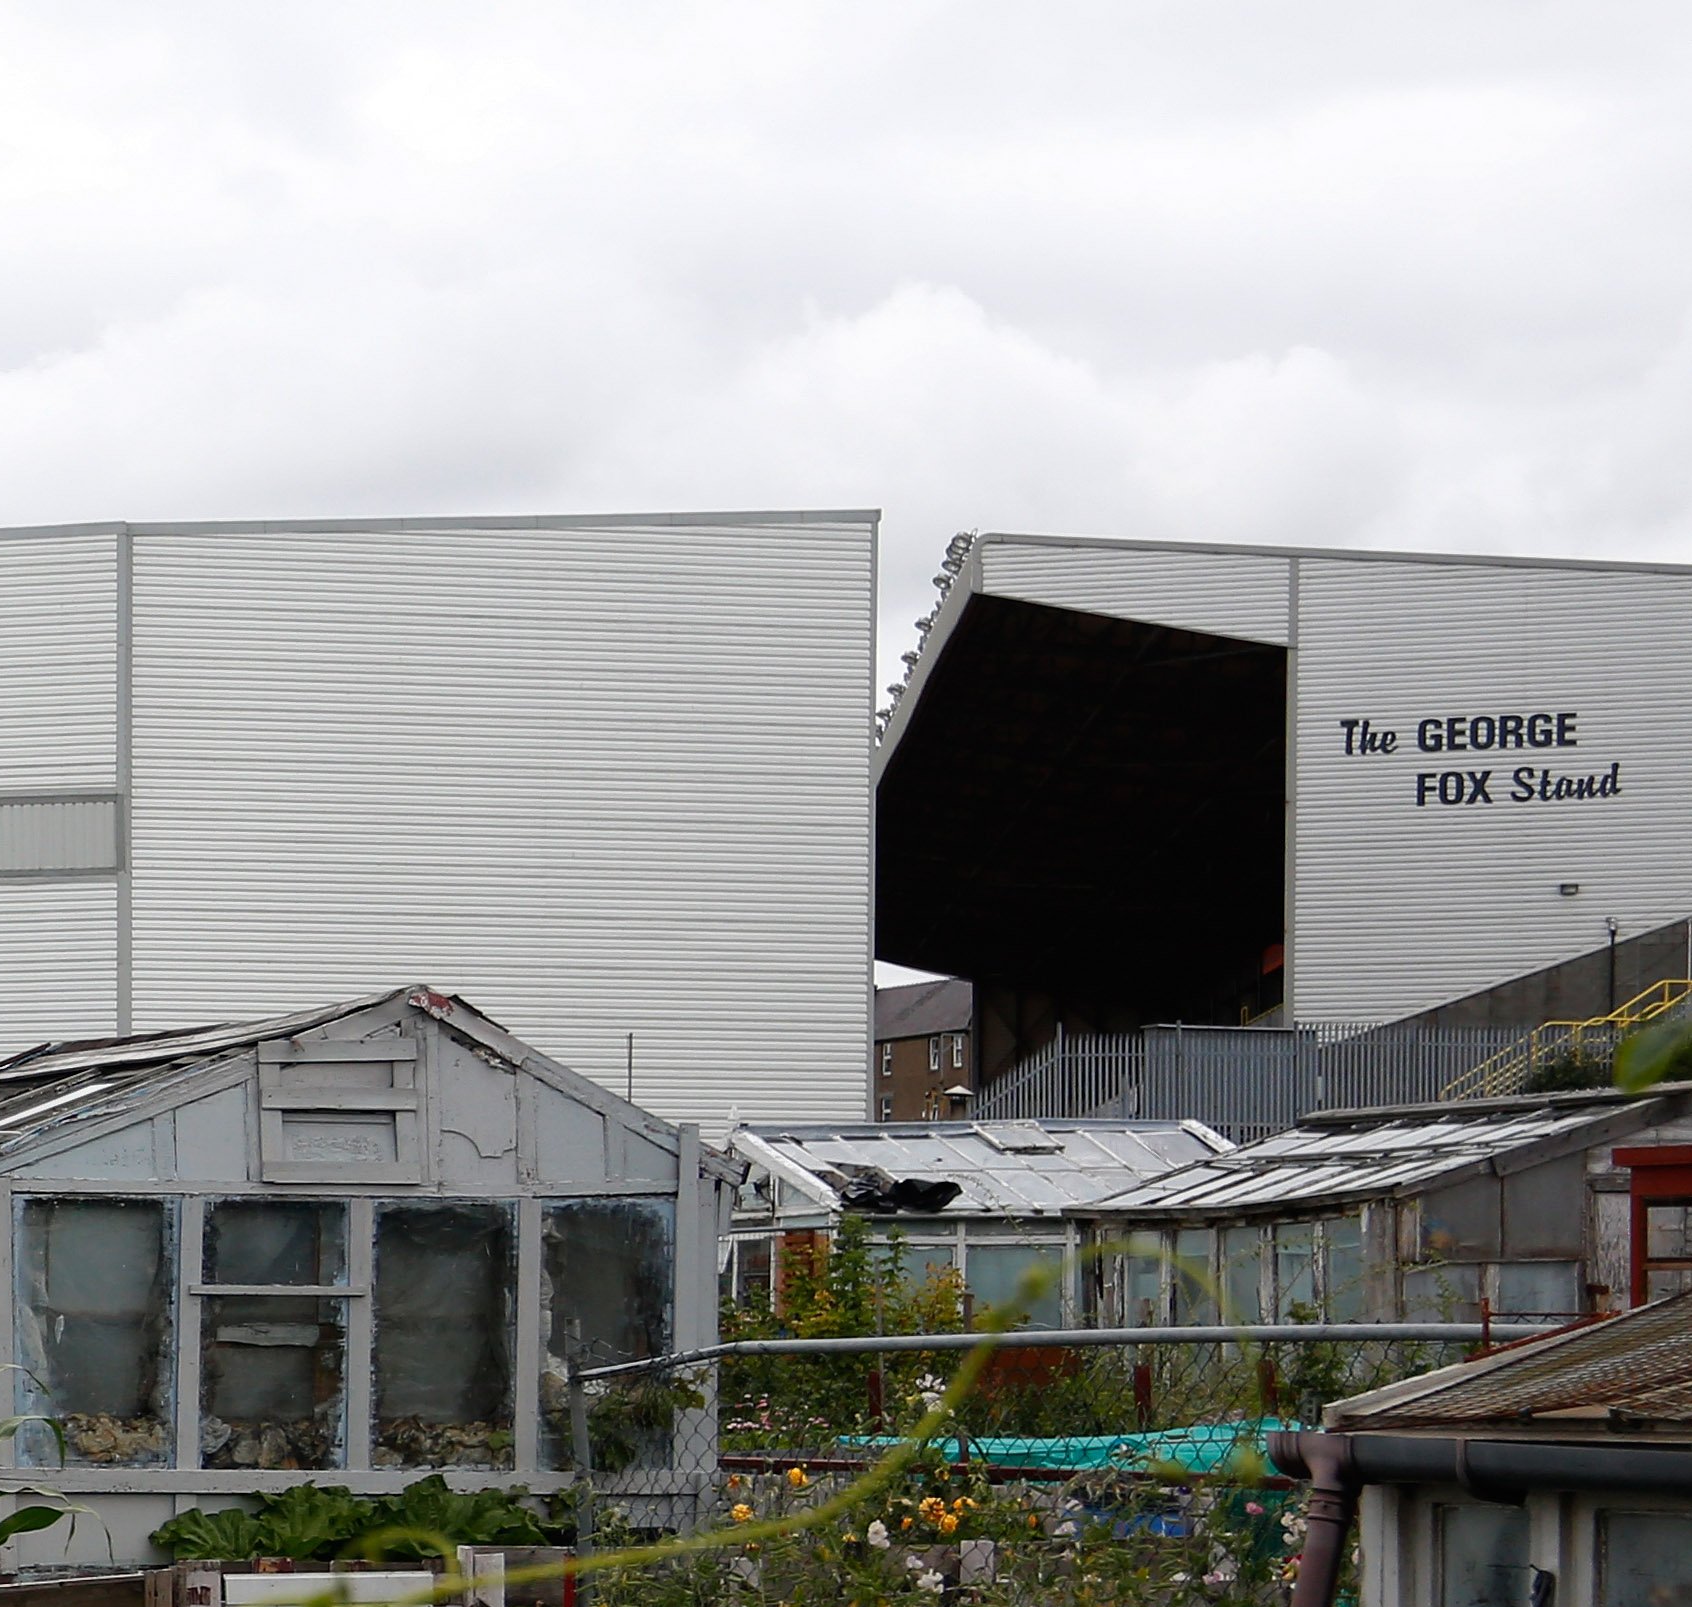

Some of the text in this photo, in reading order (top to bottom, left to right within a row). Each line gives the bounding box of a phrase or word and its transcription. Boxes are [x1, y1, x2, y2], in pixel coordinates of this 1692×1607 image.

[1339, 713, 1578, 756] The GEORGE
[1415, 762, 1623, 807] FOX Stand
